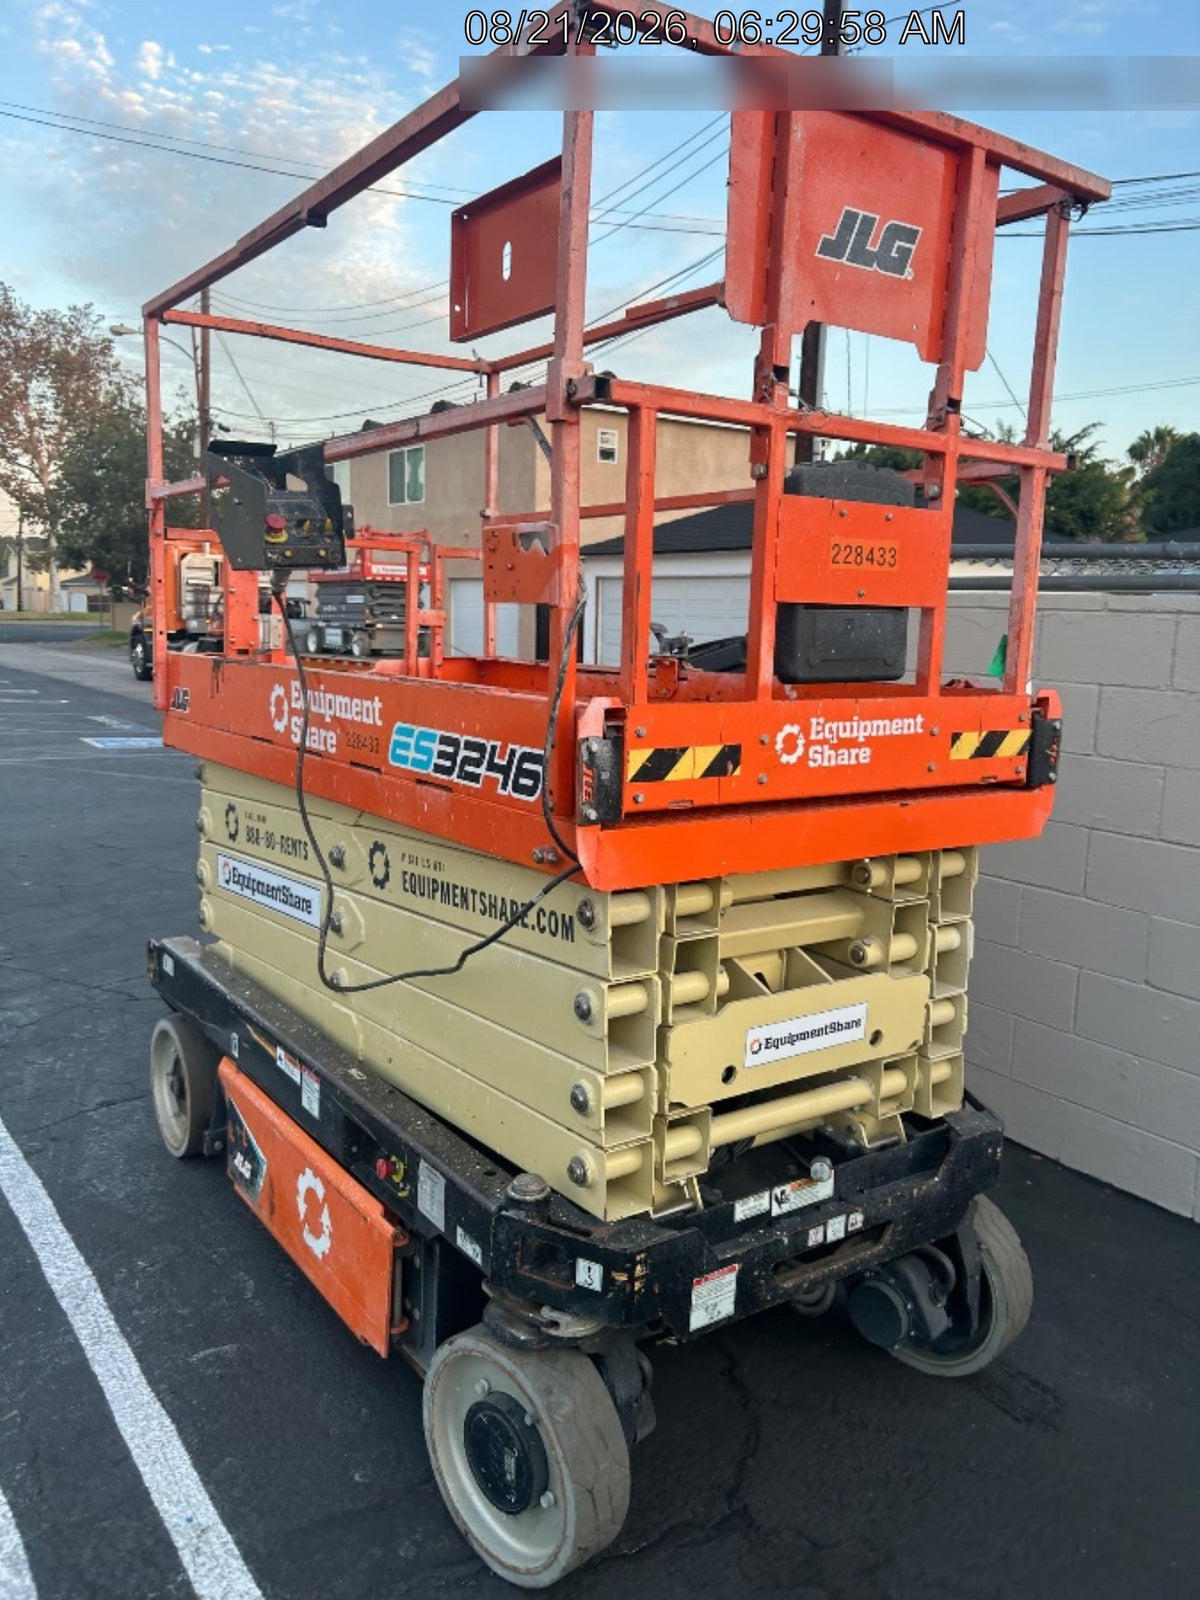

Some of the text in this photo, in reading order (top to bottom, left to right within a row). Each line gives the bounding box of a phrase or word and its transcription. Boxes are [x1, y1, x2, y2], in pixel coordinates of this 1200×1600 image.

[814, 206, 922, 280] JLG
[831, 543, 897, 568] 228433
[809, 714, 925, 743] Equipment
[388, 721, 546, 802] ES3246
[807, 745, 871, 768] Share
[232, 867, 312, 915] EquipmentShare
[402, 871, 574, 943] EQUIPMENTSHARE.COM
[764, 1018, 861, 1050] EquipmentShare
